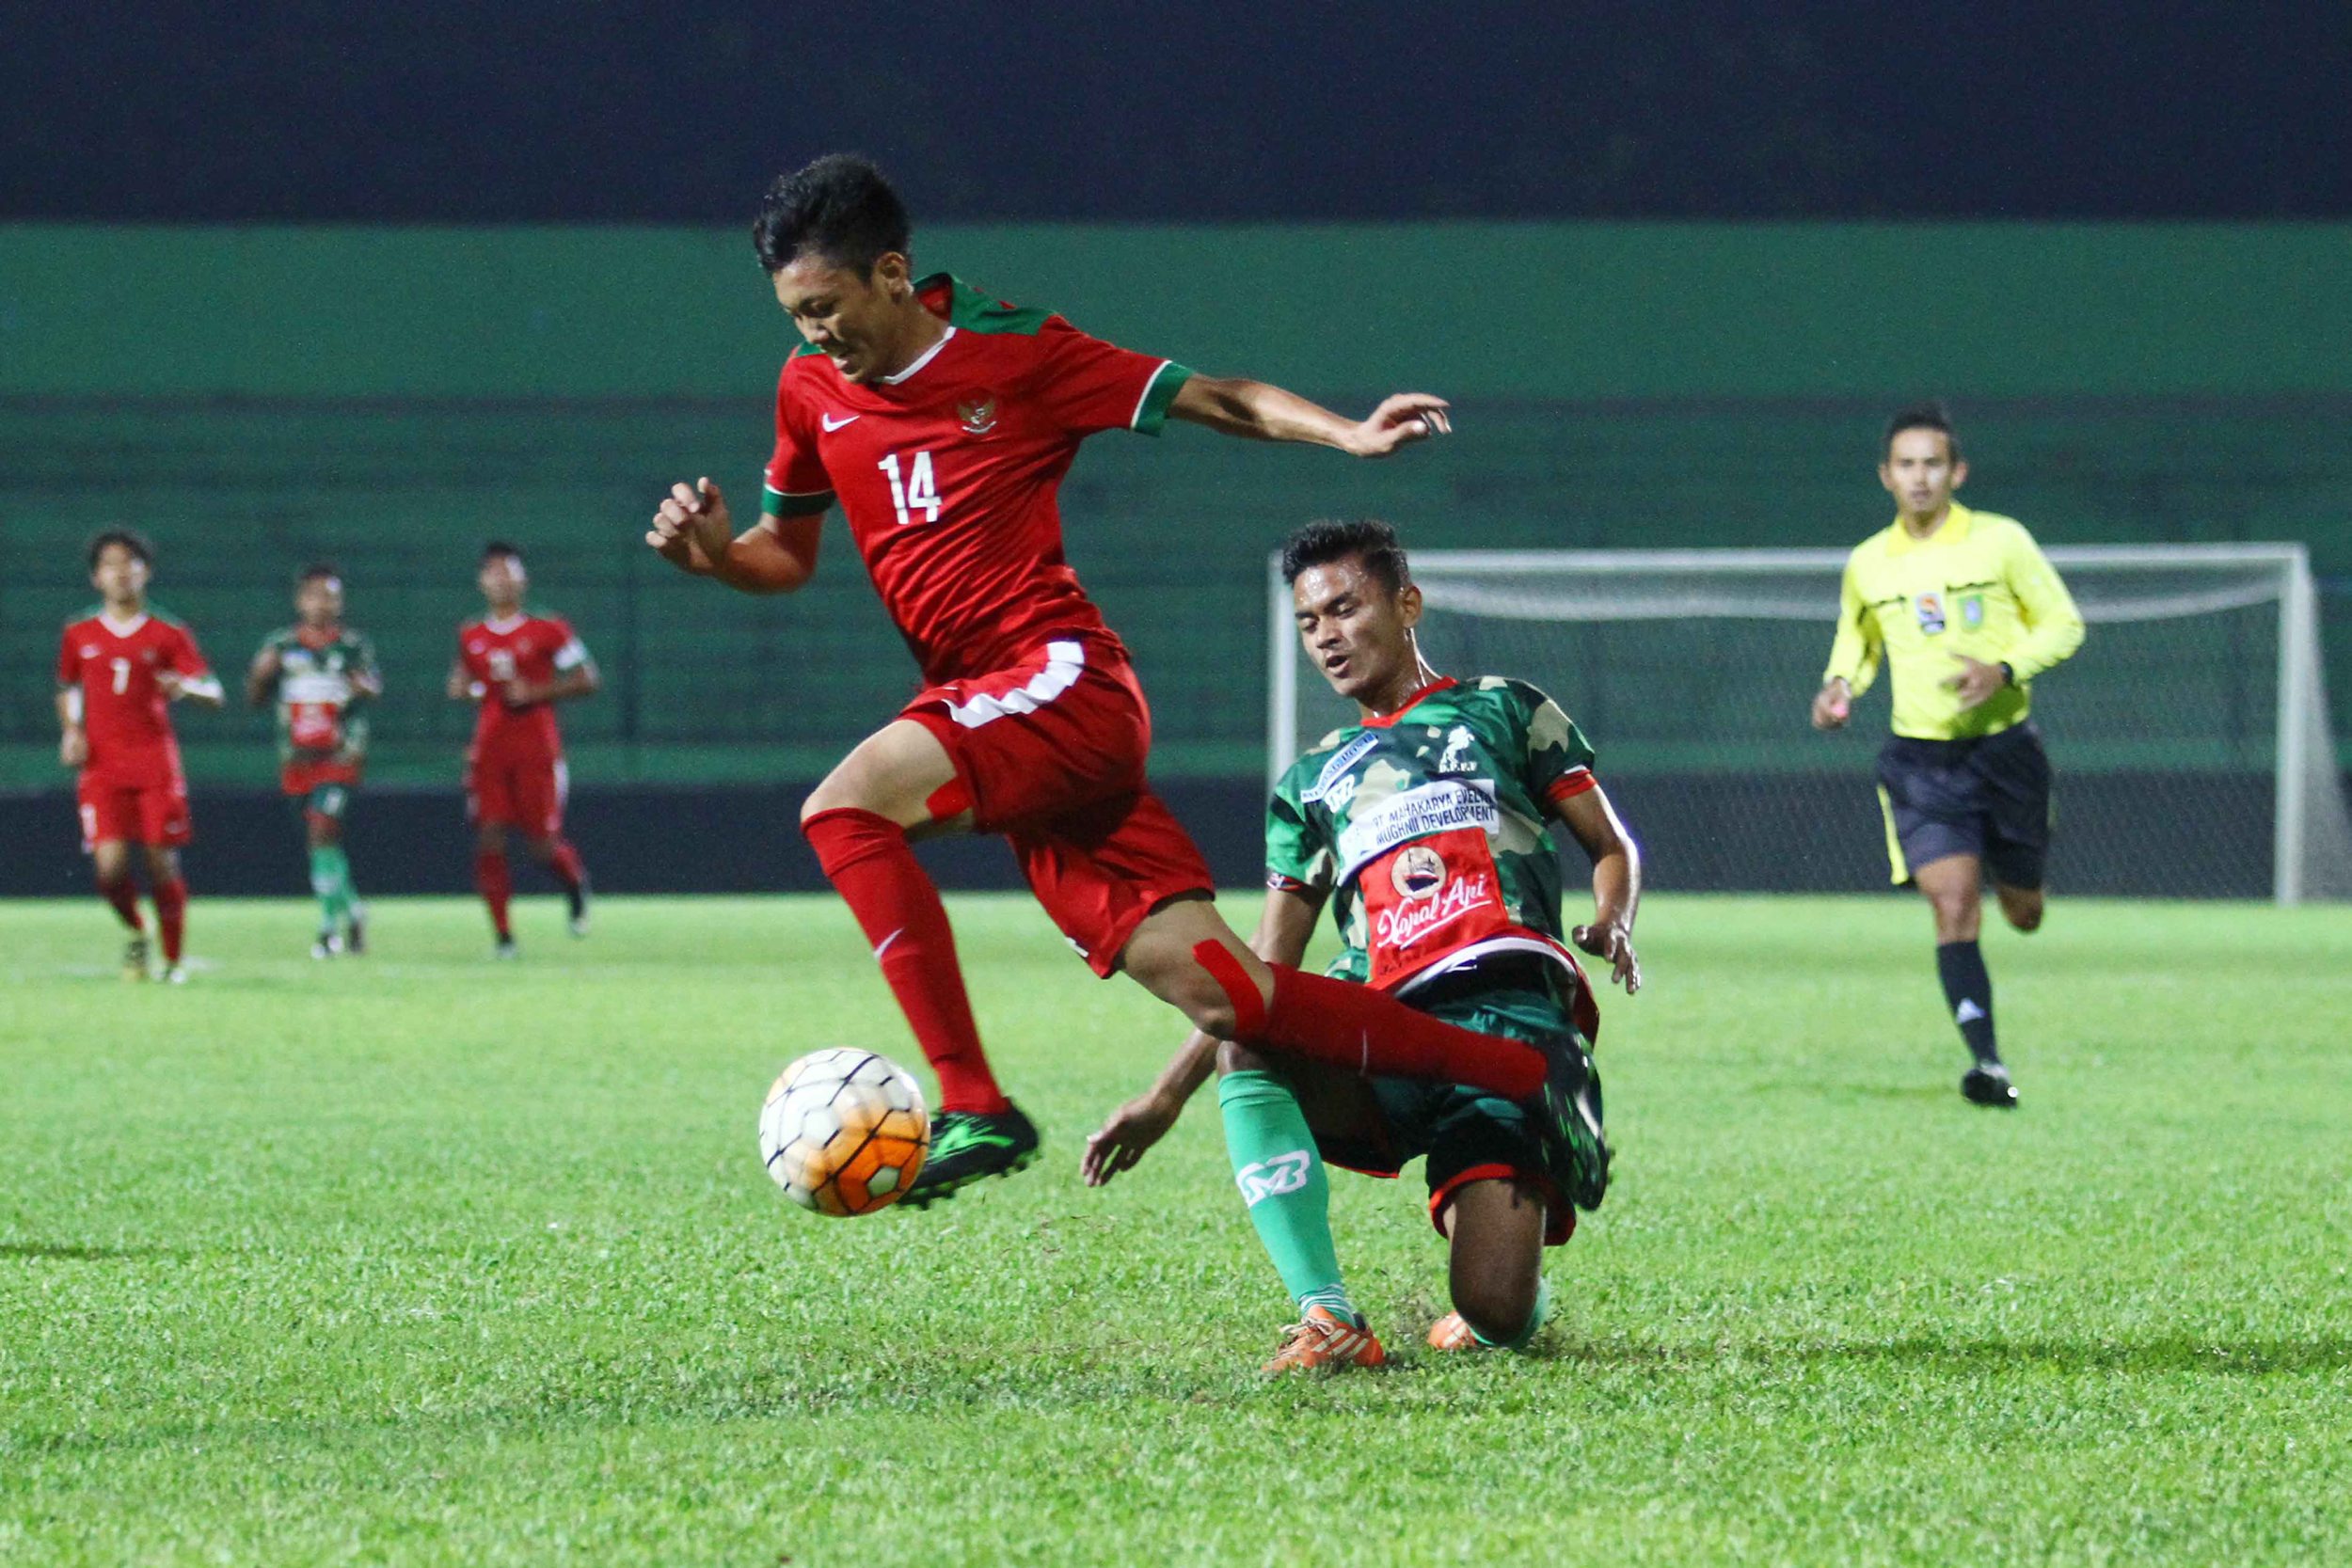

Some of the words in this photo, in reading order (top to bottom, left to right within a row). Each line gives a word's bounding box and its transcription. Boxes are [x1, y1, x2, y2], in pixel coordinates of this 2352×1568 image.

[878, 451, 941, 525] 14
[1389, 793, 1454, 822] MAHAKARYA
[1422, 805, 1494, 832] DEVELOPMENT
[1440, 874, 1486, 916] Api
